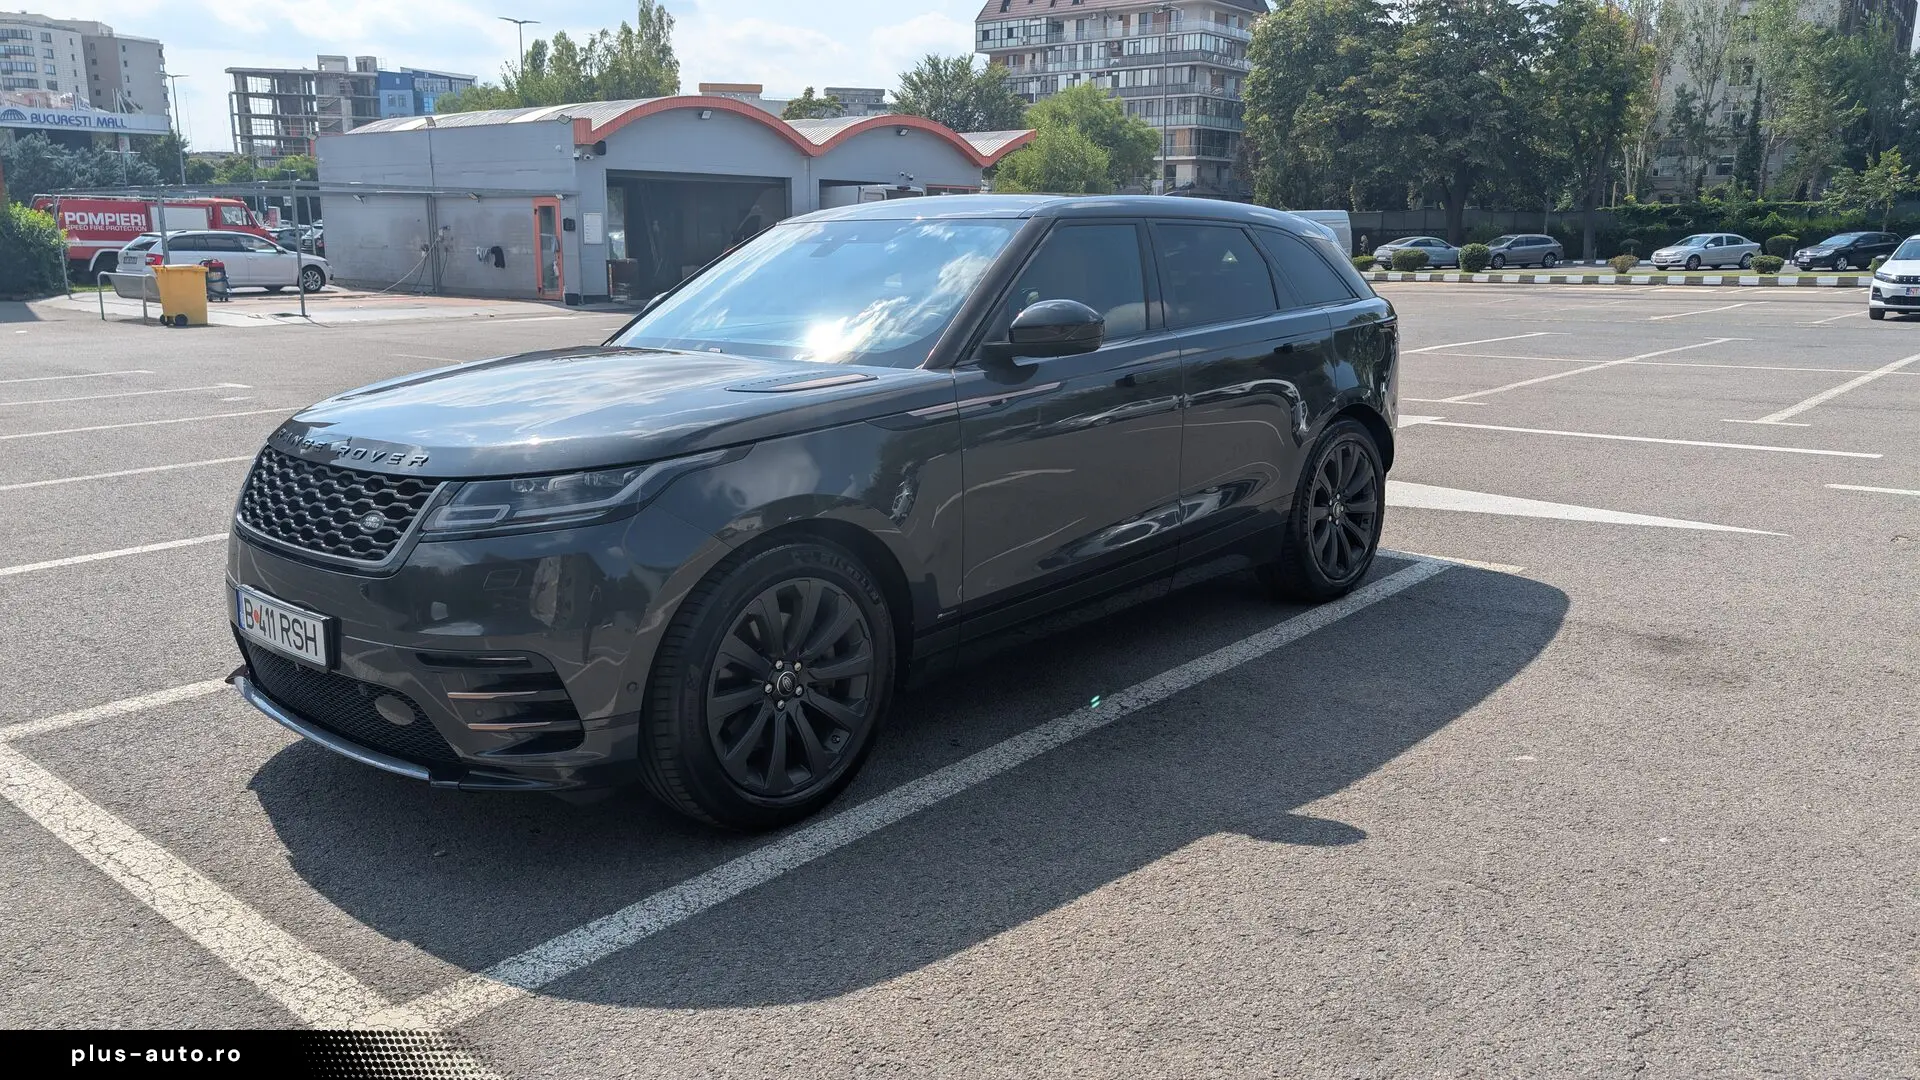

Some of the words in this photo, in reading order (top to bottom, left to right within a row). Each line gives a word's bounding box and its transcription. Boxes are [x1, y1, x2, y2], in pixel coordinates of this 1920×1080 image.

[96, 116, 127, 128] MALL
[64, 211, 146, 226] POMPIERI
[276, 427, 328, 452] RANGE
[336, 444, 430, 468] ROVER
[244, 597, 255, 630] B
[259, 604, 277, 641] 411
[279, 612, 318, 657] RSH
